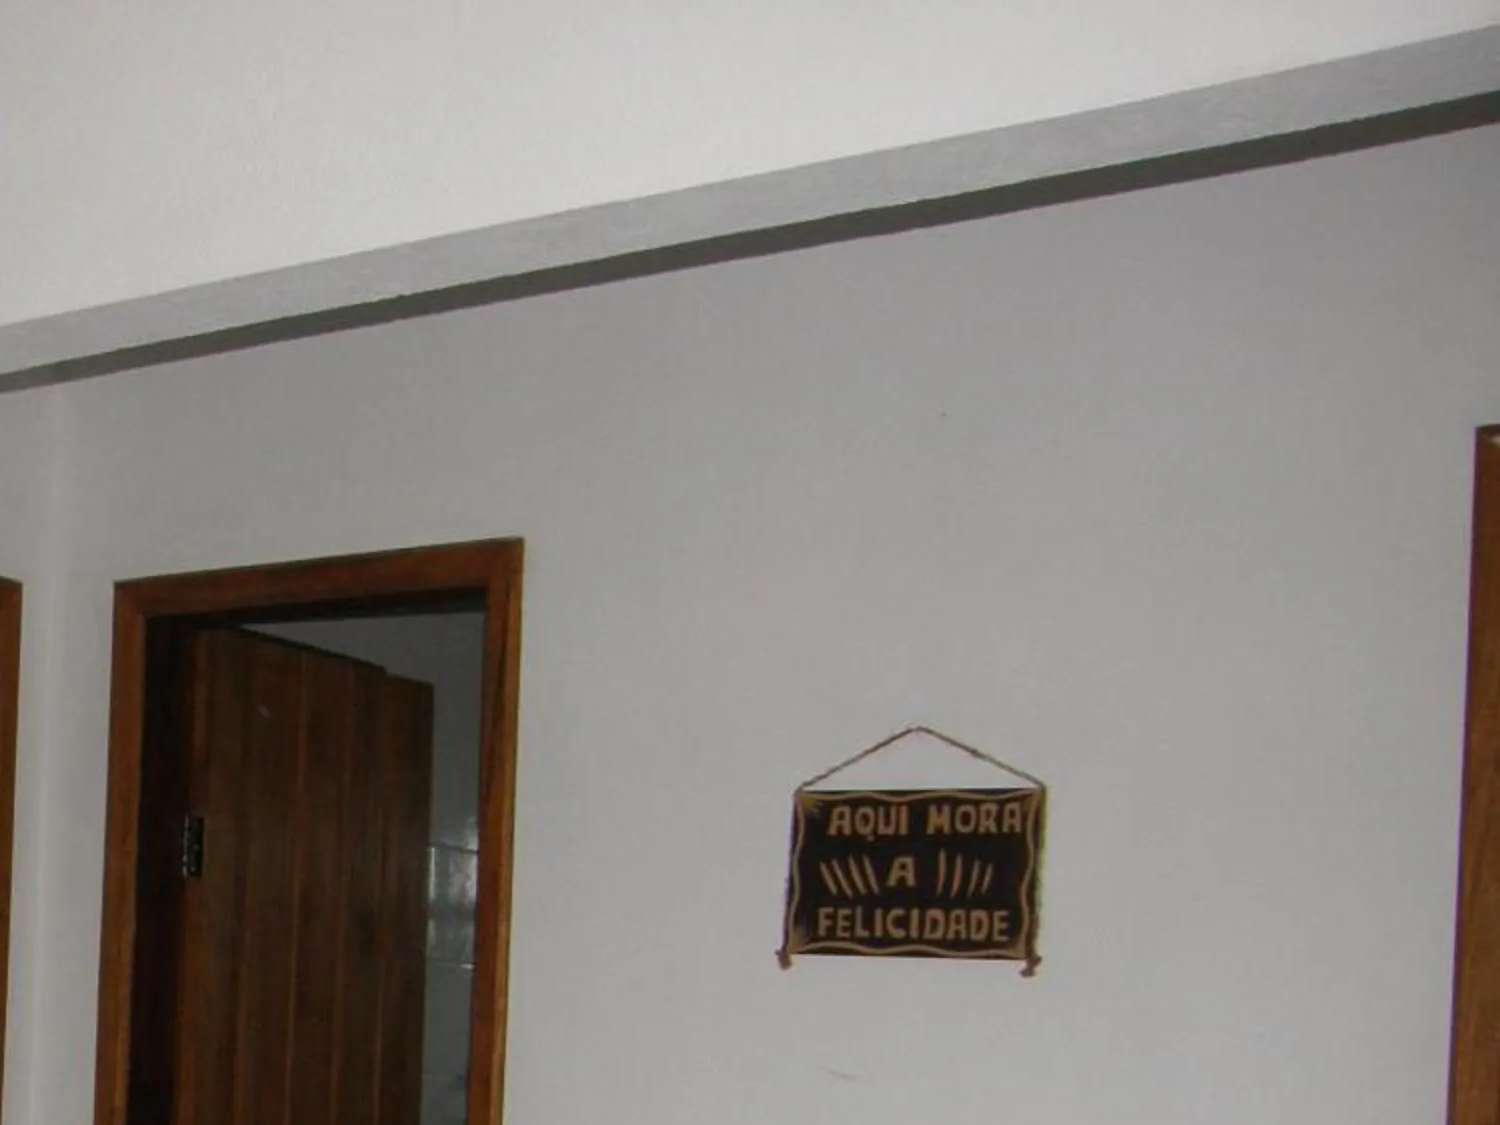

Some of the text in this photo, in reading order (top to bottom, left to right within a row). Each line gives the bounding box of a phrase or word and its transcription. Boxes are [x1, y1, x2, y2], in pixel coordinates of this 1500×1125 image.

[827, 801, 1021, 841] AQUI MORA
[886, 856, 917, 887] A
[817, 905, 1010, 942] FELICIDADE
